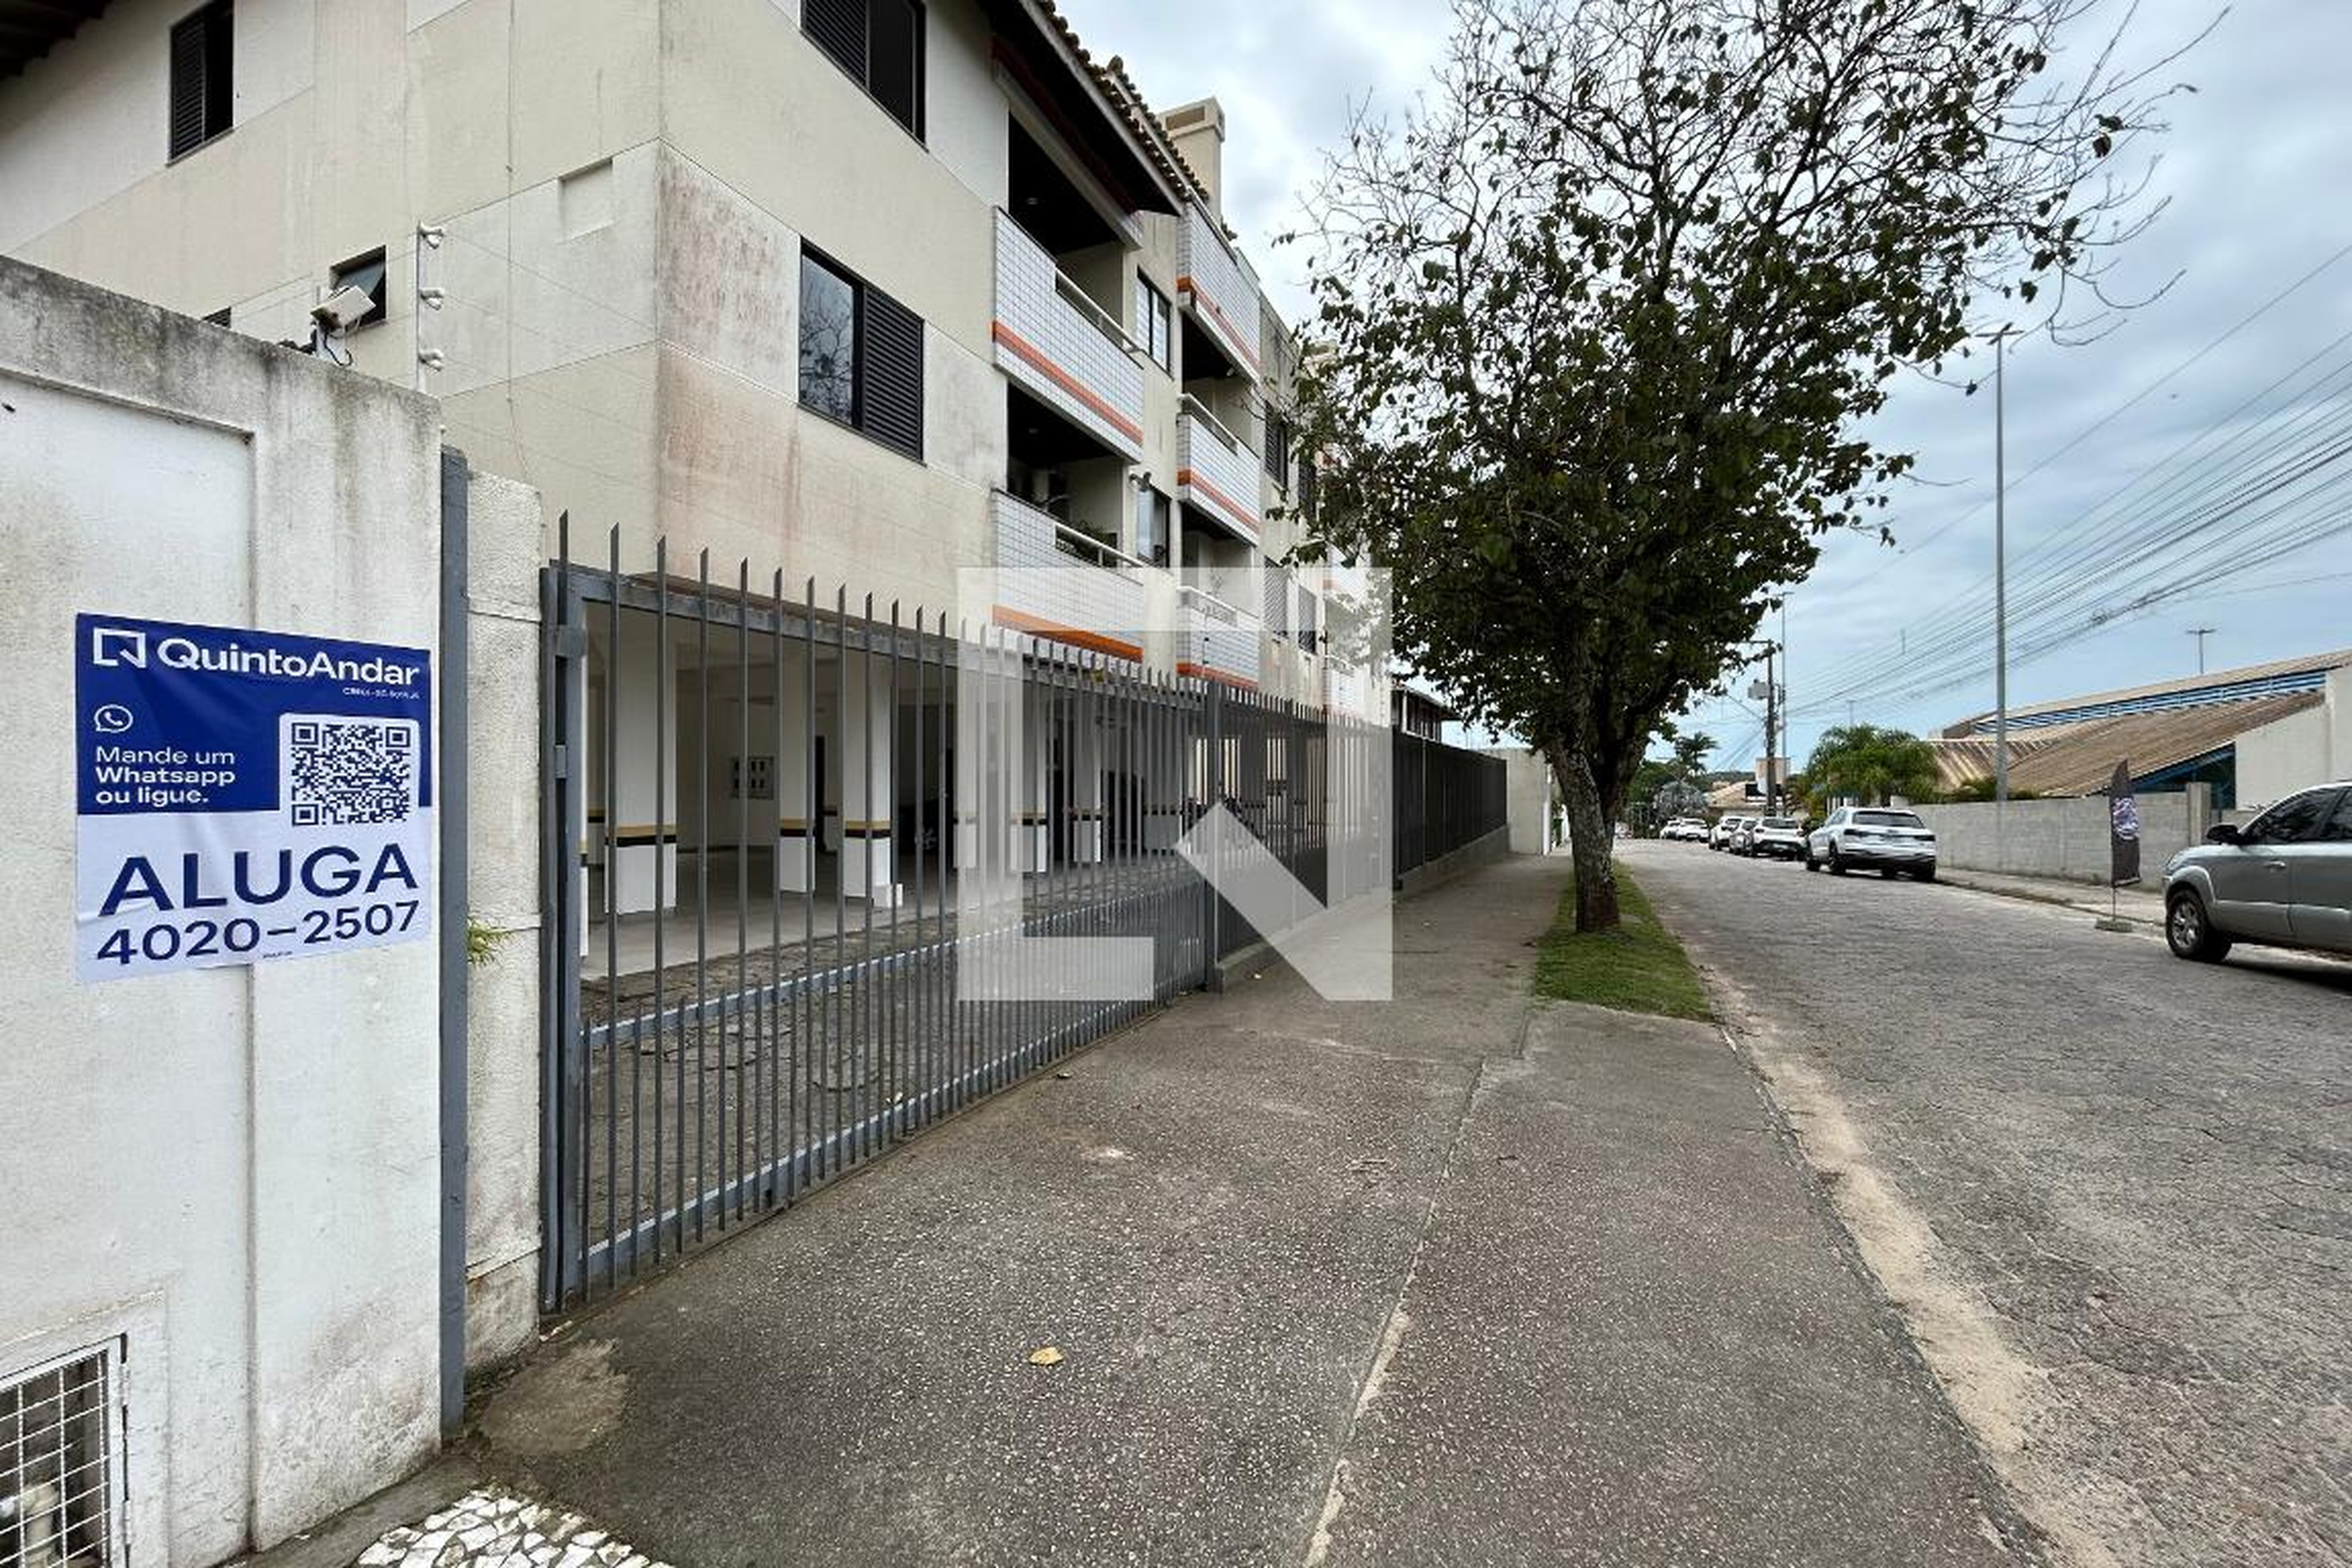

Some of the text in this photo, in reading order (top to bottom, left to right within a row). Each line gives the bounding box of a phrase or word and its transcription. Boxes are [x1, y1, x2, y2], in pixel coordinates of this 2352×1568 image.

[157, 638, 420, 685] QuintoAndar
[97, 746, 235, 764] Mande um
[96, 766, 235, 786] Whatsapp
[96, 786, 208, 807] ou ligue.
[98, 843, 418, 918] ALUGA
[96, 900, 419, 965] 4020-2507
